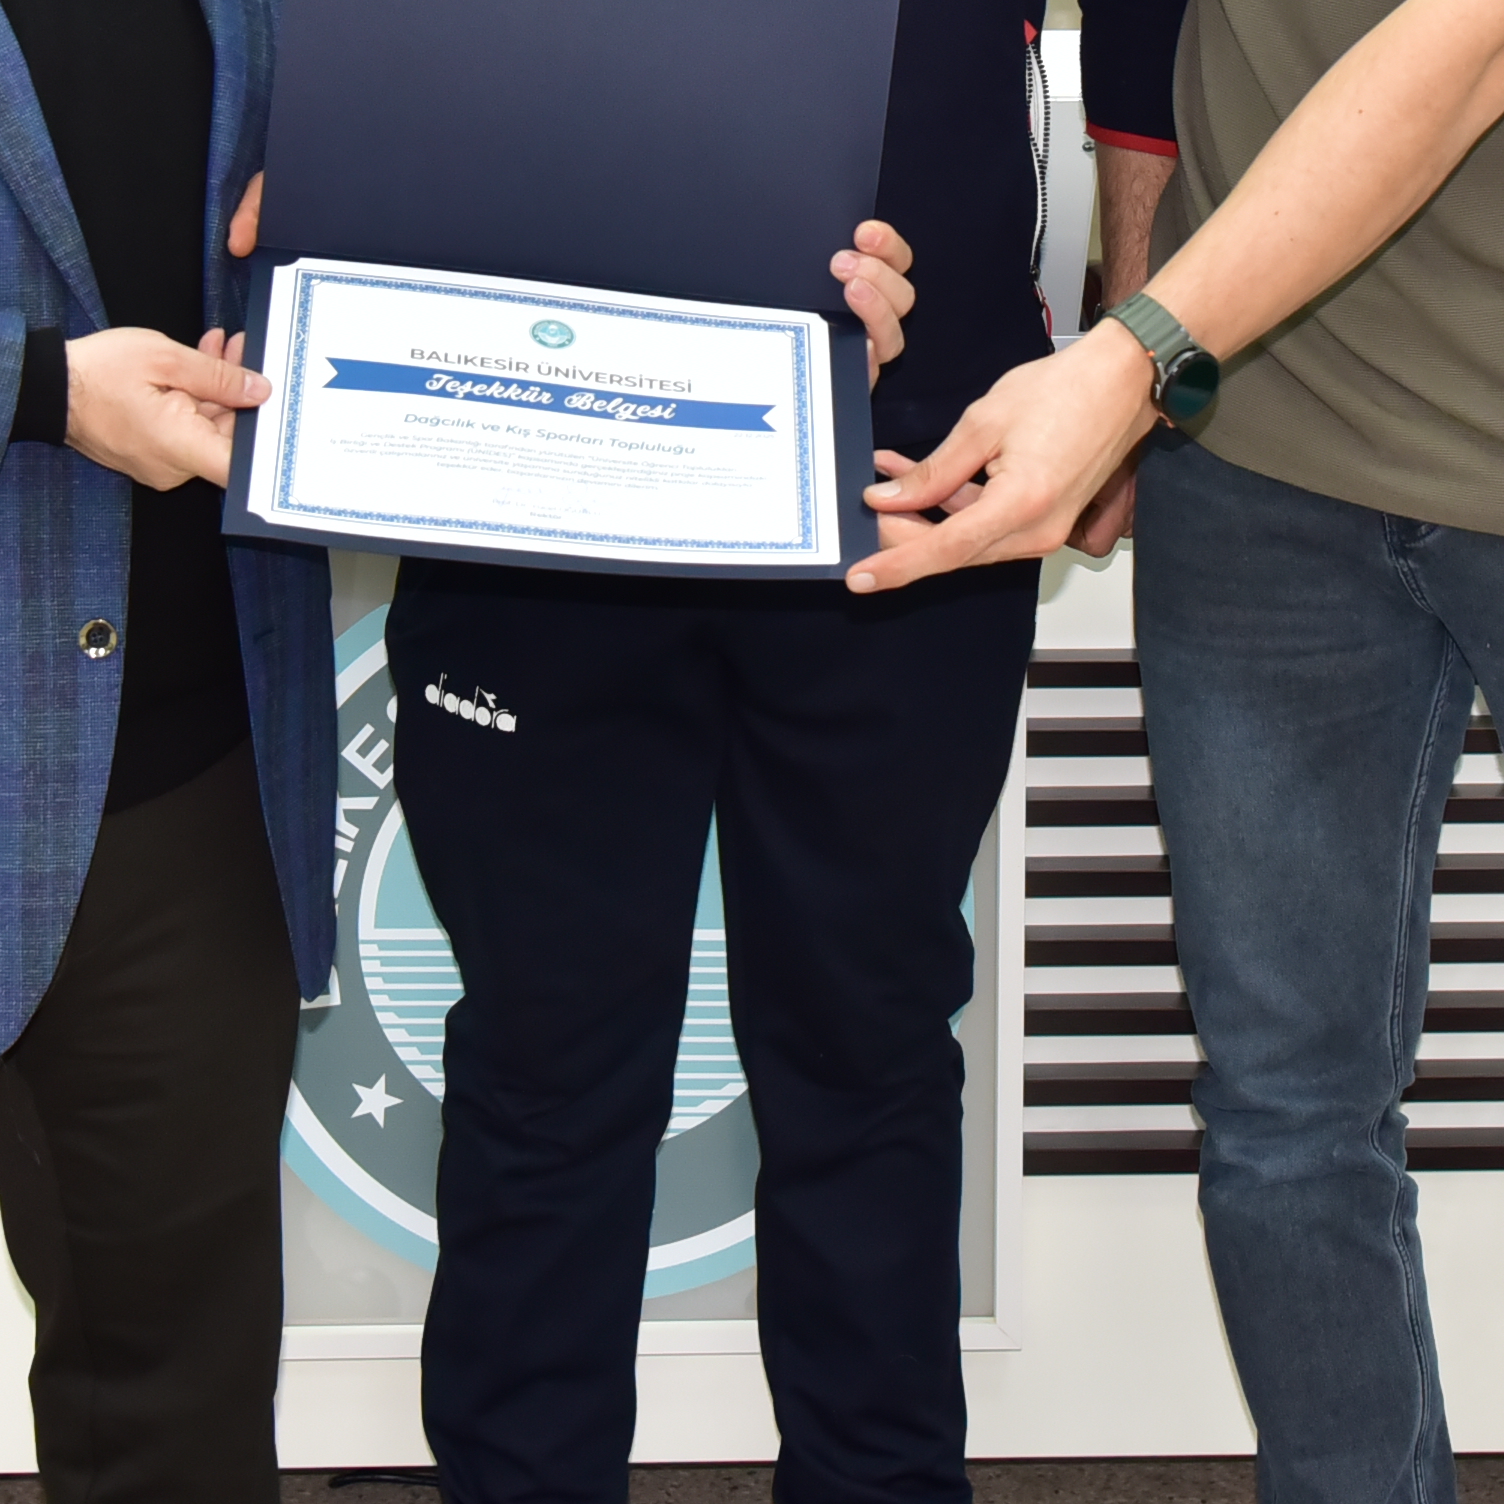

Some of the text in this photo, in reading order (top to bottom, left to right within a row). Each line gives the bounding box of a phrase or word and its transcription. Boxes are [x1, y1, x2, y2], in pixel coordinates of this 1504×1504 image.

[410, 348, 693, 393] BALIKESİR ÜNİVERSİTESİ
[425, 374, 676, 421] Teşekkür Belgesi
[404, 414, 695, 455] Dağcılık ve Kış Sporları Topluluğu
[425, 672, 516, 733] diadora
